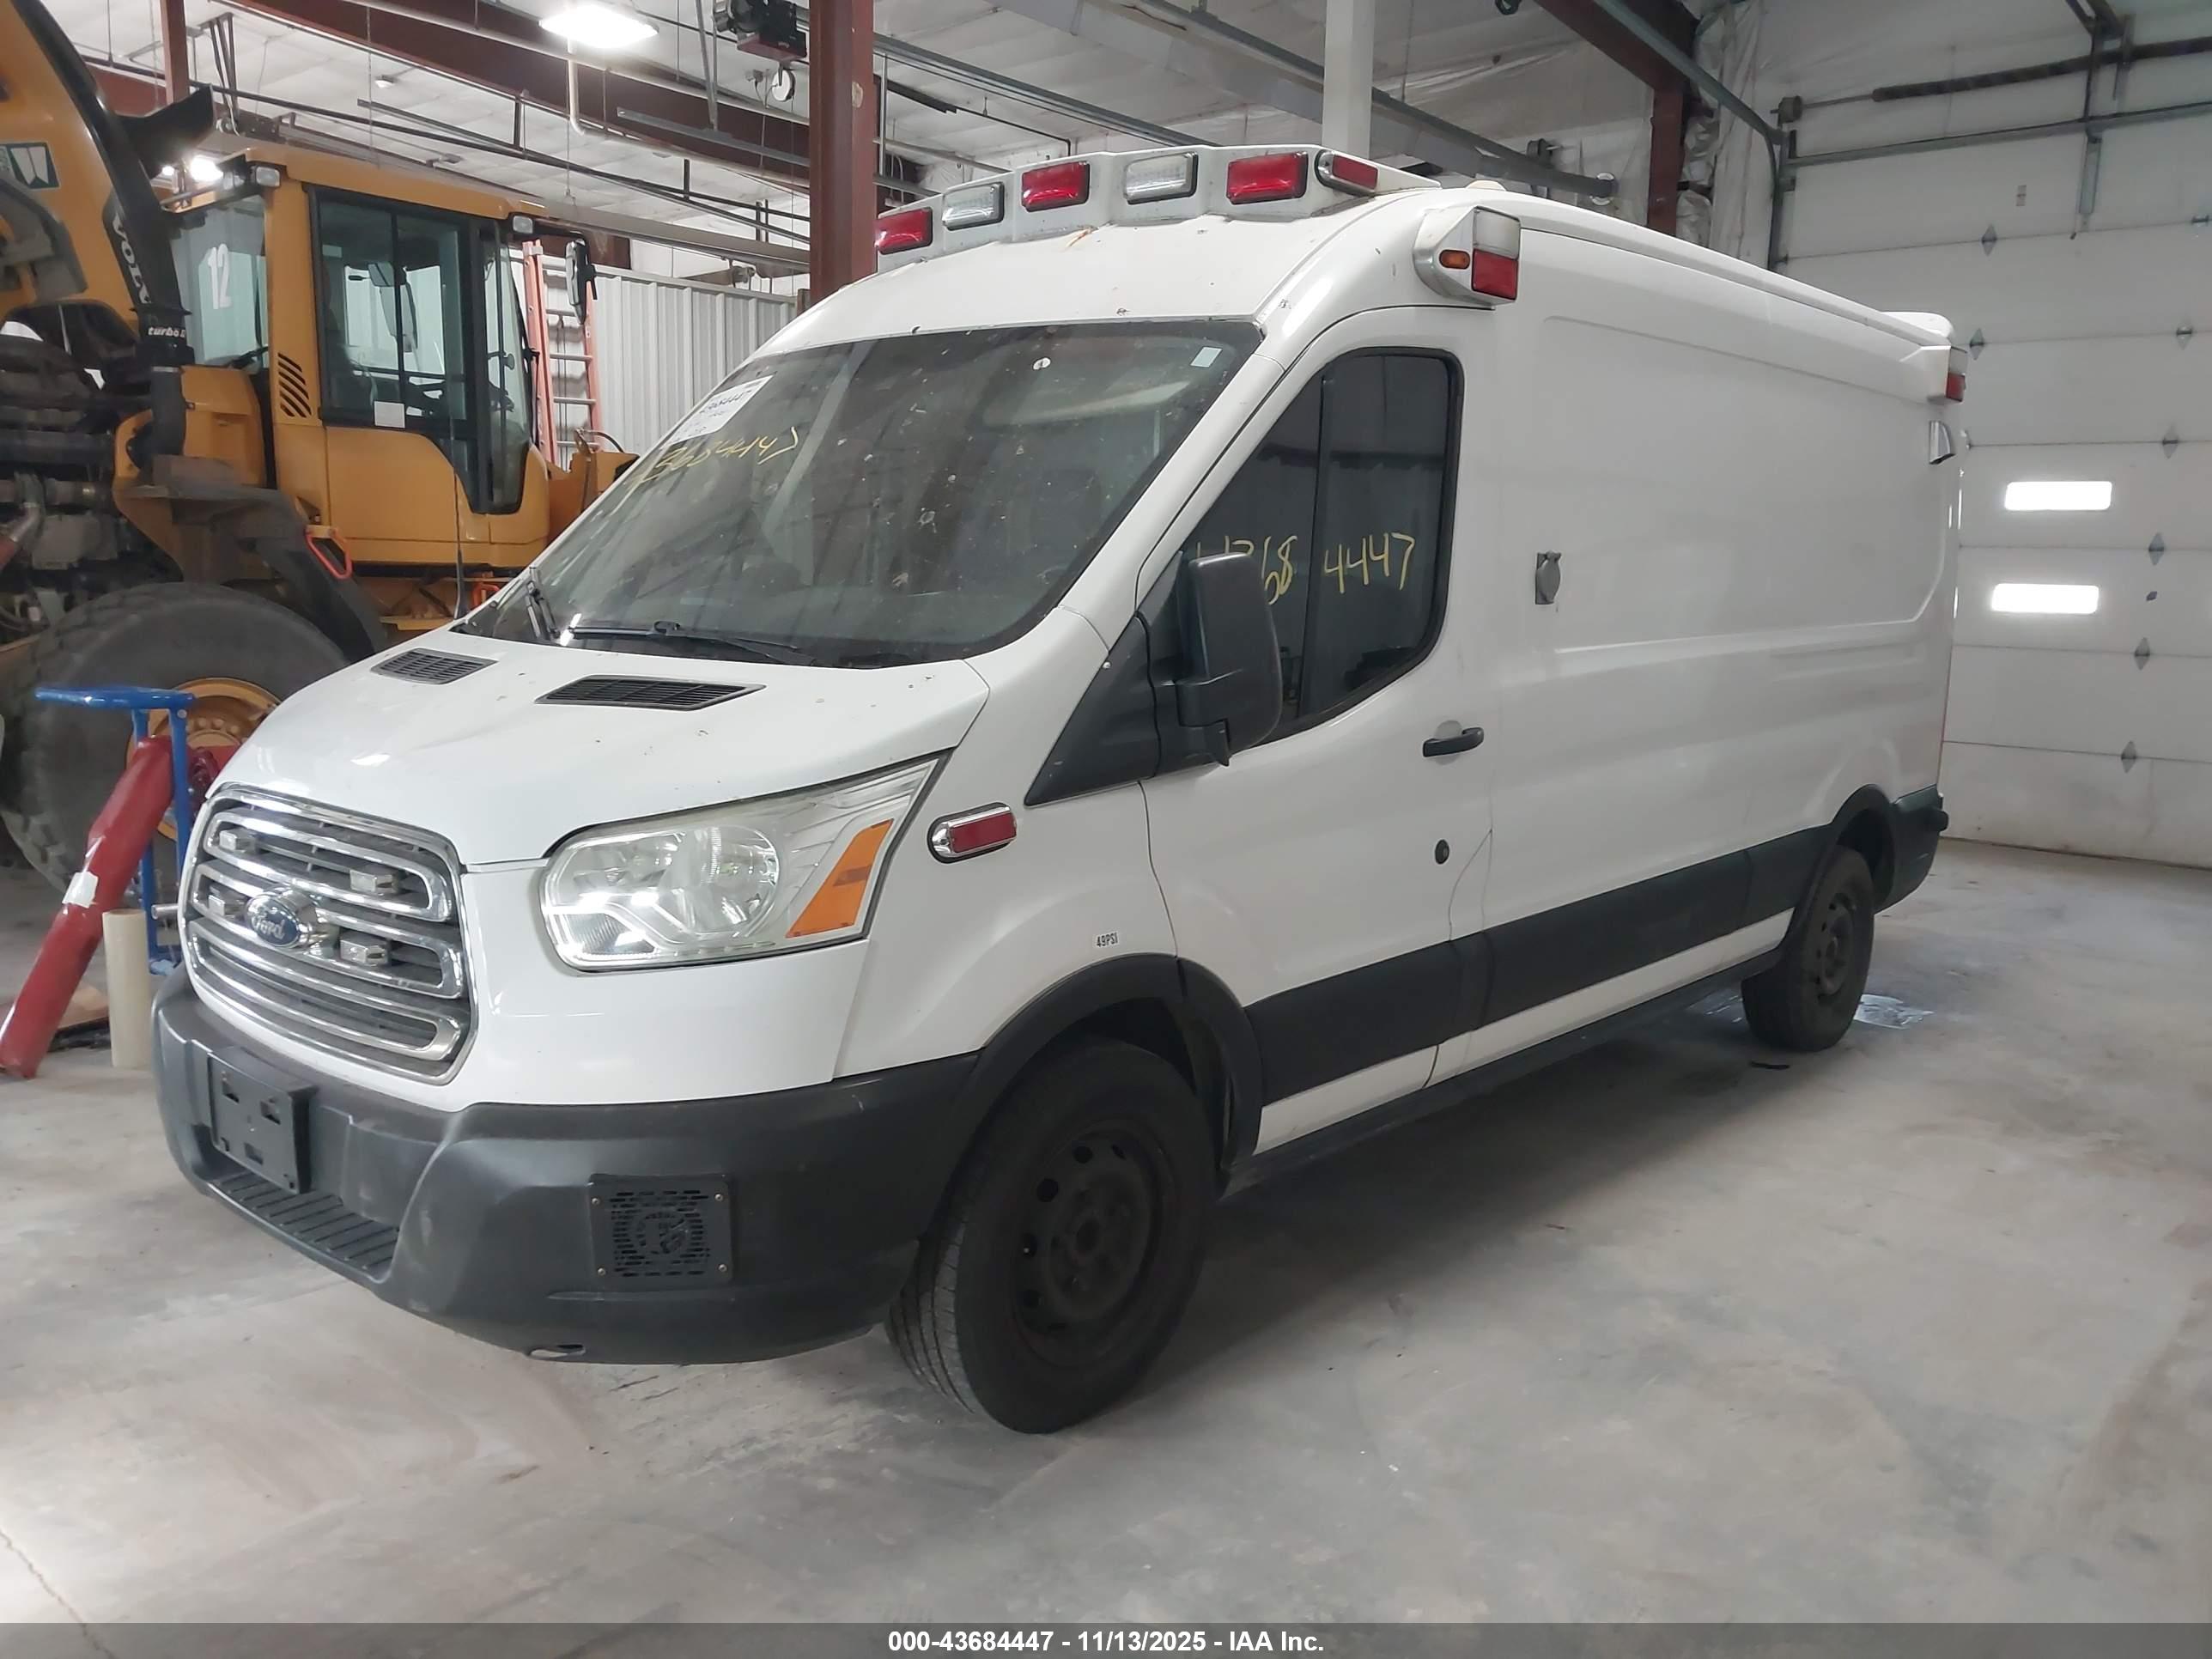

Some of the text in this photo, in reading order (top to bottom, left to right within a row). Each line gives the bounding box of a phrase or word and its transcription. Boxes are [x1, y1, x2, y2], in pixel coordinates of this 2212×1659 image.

[208, 243, 233, 310] 12
[148, 326, 179, 337] turbo
[1324, 532, 1415, 594] 4447
[252, 912, 286, 940] Ford
[1096, 932, 1119, 947] 49PSI
